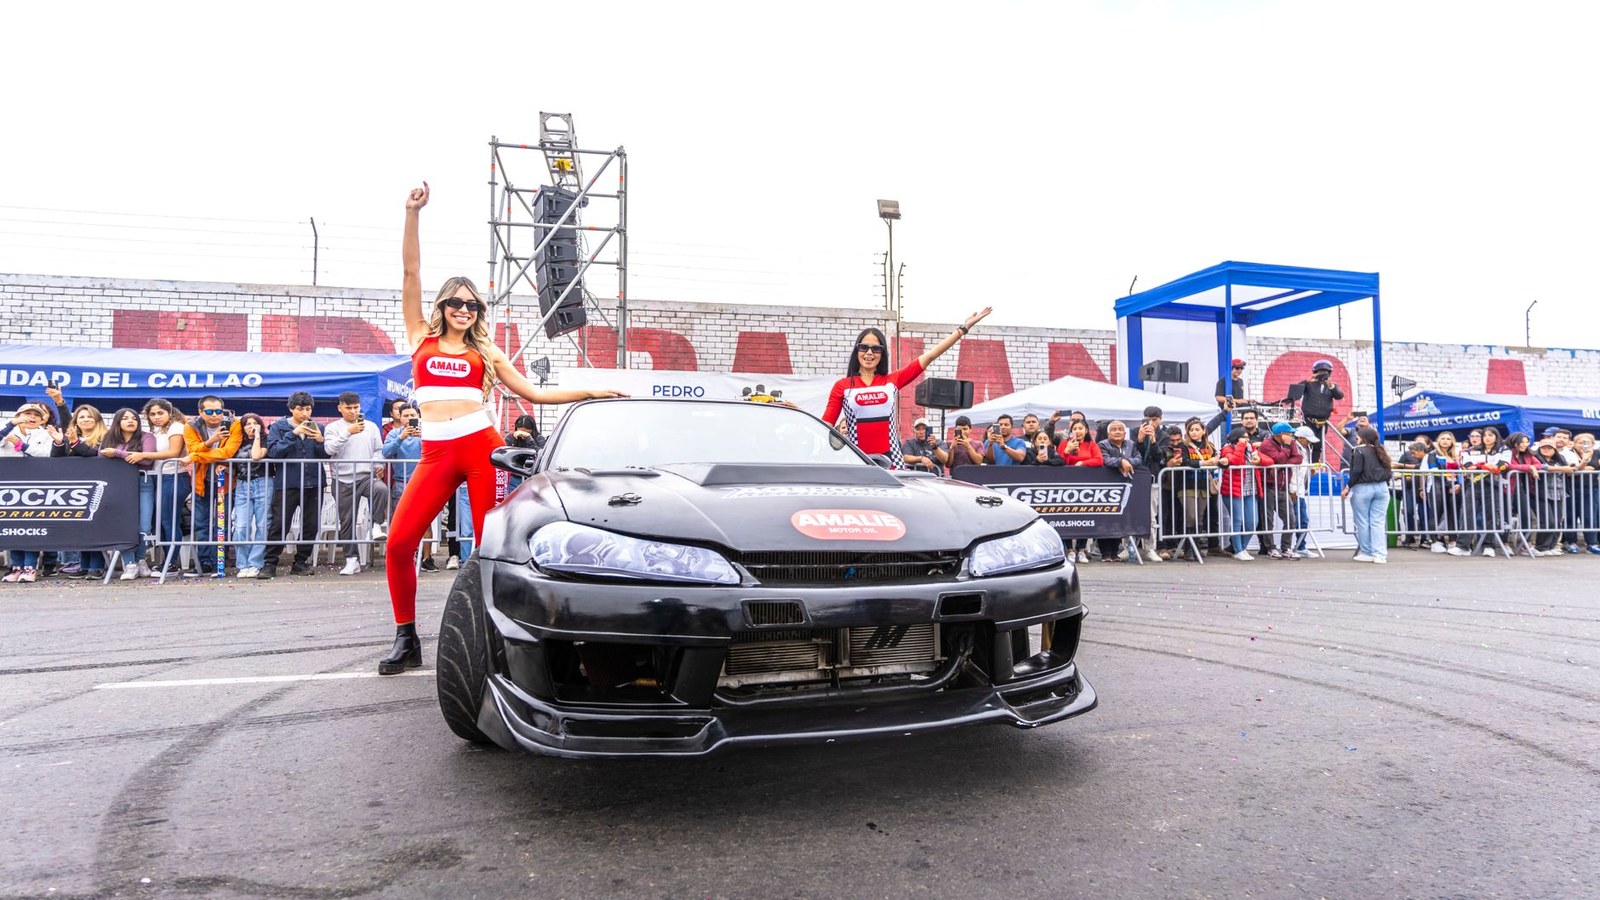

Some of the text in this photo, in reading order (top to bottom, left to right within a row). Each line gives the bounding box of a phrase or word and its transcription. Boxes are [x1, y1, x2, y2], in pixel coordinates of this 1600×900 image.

[430, 360, 467, 372] AMALIE
[0, 369, 263, 388] IDAD DEL CALLAO
[652, 385, 705, 397] PEDRO
[857, 392, 886, 401] AMALIE
[1431, 416, 1453, 426] DEL
[1454, 411, 1500, 423] CALLAO
[0, 489, 90, 506] OCKS
[799, 513, 900, 526] AMALIE
